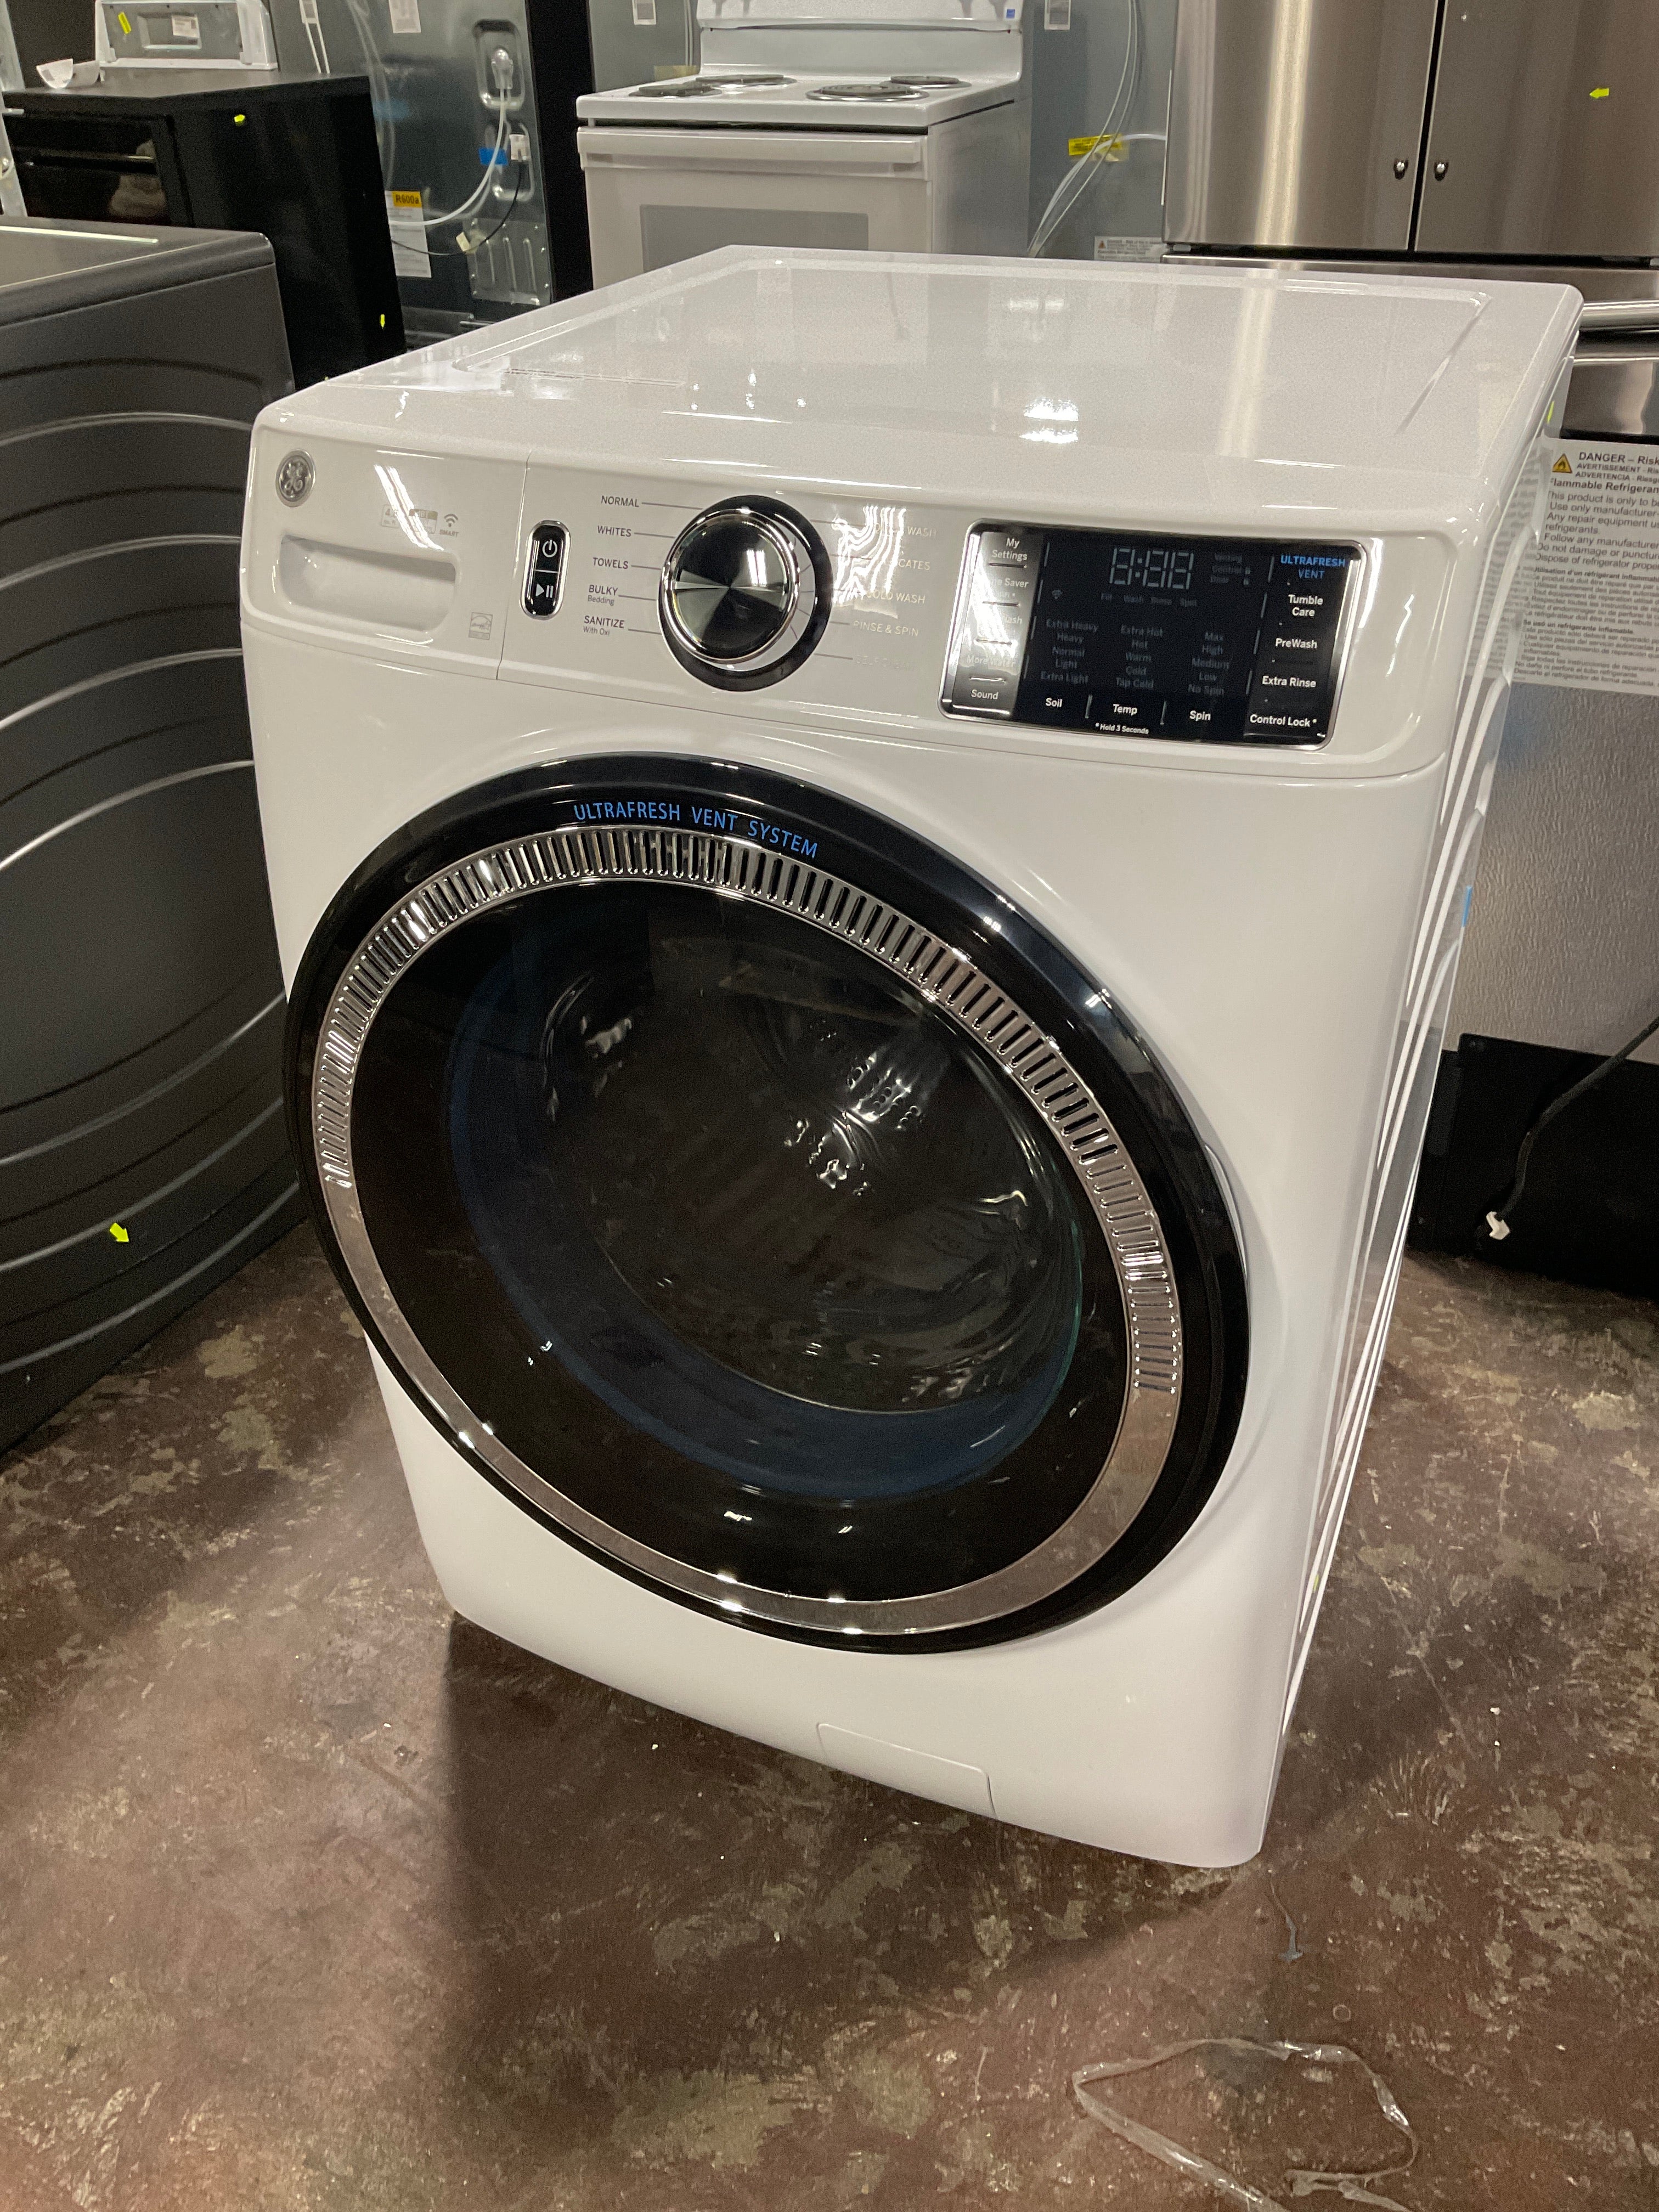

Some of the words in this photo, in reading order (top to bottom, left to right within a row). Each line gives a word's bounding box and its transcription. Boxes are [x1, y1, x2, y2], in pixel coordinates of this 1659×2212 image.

[395, 194, 420, 205] R600a
[1578, 452, 1626, 464] DANGER
[1576, 463, 1641, 472] AVERTISSEMENT
[1575, 471, 1630, 481] ADVERTENCIA
[1637, 475, 1659, 484] Riesg
[1605, 482, 1659, 494] Refrigeran
[601, 495, 640, 508] NORMAL
[1567, 494, 1603, 503] product
[1616, 496, 1637, 507] only
[1550, 501, 1568, 511] Use
[1571, 505, 1590, 514] only
[1547, 512, 1565, 523] Any
[1567, 515, 1596, 524] repair
[1598, 517, 1648, 528] equipment
[439, 529, 460, 537] SMART
[597, 525, 632, 538] WHITES
[1006, 537, 1020, 549] My
[1544, 532, 1575, 542] Follow
[1577, 536, 1595, 546] any
[991, 549, 1028, 562] Settings
[1569, 546, 1607, 557] damage
[1622, 551, 1659, 560] punctur
[592, 557, 629, 569] TOWELS
[1280, 554, 1346, 567] ULTRAFRESH
[1582, 558, 1630, 568] refrigerator
[1298, 568, 1325, 580] VENT
[1004, 578, 1030, 589] Saver
[588, 584, 619, 596] BULKY
[587, 595, 615, 606] Bedding
[895, 591, 926, 604] WASH
[1288, 594, 1324, 606] Tumble
[1291, 606, 1316, 618] Care
[584, 615, 625, 629] SANITIZE
[1046, 618, 1069, 629] Extra
[1071, 621, 1099, 633] Heavy
[583, 626, 598, 635] With
[599, 628, 611, 636] Oxi
[885, 624, 892, 634] &
[895, 625, 919, 636] SPIN
[1121, 624, 1144, 636] Extra
[1057, 632, 1085, 645] Heavy
[1131, 639, 1148, 650] Hot
[1275, 637, 1317, 650] PreWash
[1052, 646, 1085, 658] Normal
[1125, 651, 1152, 663] Warm
[966, 654, 988, 665] More
[989, 656, 1017, 668] Water
[1056, 659, 1077, 670] Light
[1126, 665, 1147, 676] Cold
[1199, 672, 1218, 681] Low
[1041, 670, 1064, 681] Extra
[1066, 673, 1089, 685] Light
[1116, 677, 1131, 689] Tap
[1133, 679, 1154, 690] Cold
[1262, 675, 1288, 687] Extra
[1290, 677, 1317, 689] Rinse
[970, 689, 999, 700] Sound
[1188, 684, 1201, 693] No
[1204, 685, 1224, 696] Spin
[1045, 697, 1063, 708] Soil
[1113, 703, 1138, 716] Temp
[1189, 710, 1211, 722] Spin
[1249, 713, 1286, 726] Control
[1288, 715, 1311, 727] Lock
[1099, 723, 1115, 732] Hold
[1122, 725, 1149, 735] Seconds
[573, 802, 680, 821] ULTRAFRESH
[691, 806, 738, 831] VENT
[748, 820, 819, 859] SYSTEM
